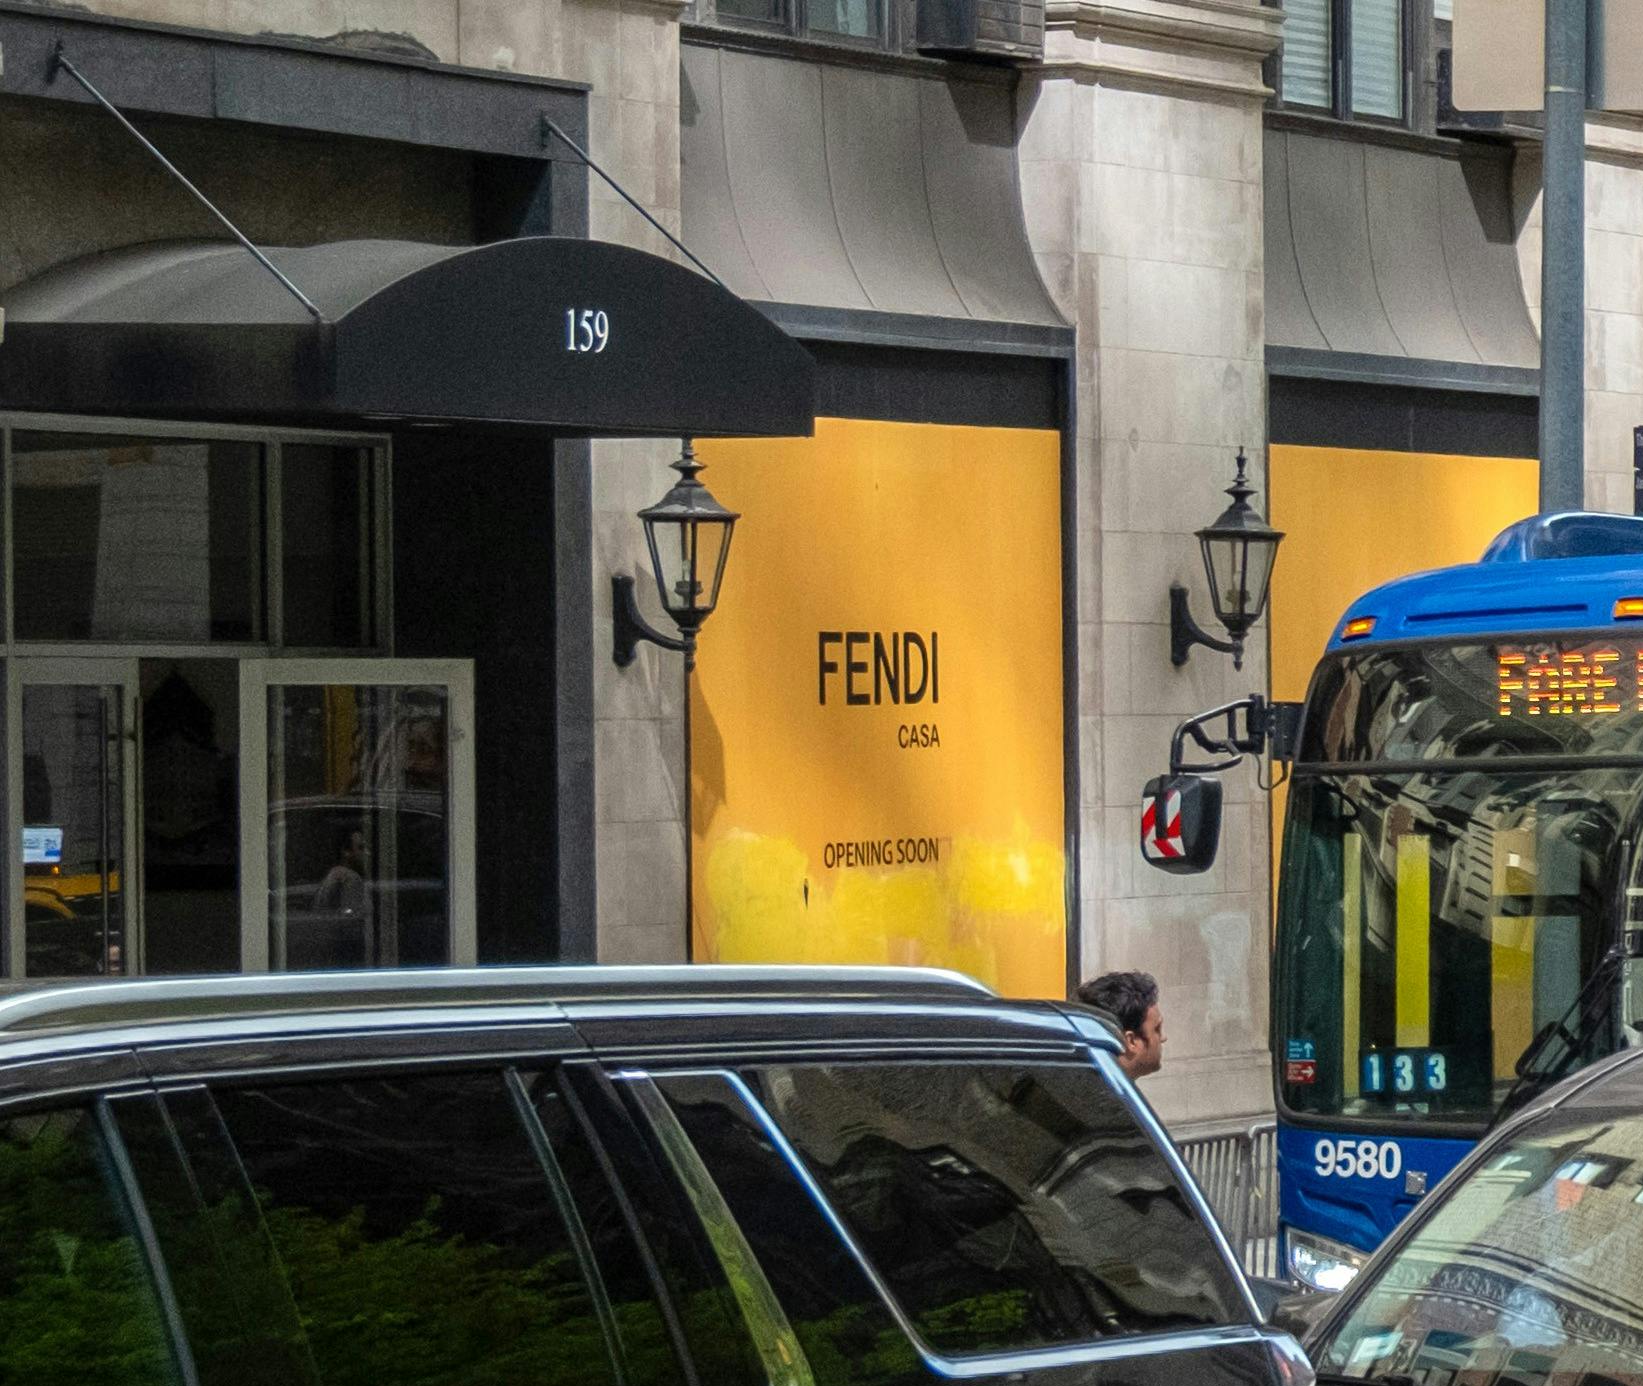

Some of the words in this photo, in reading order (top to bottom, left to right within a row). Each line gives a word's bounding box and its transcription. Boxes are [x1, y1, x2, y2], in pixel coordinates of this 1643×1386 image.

[565, 309, 610, 354] 159
[818, 630, 939, 706] FENDI
[1499, 650, 1621, 716] FARE
[898, 724, 941, 750] CASA
[823, 840, 893, 870] OPENING
[896, 837, 940, 865] SOON
[1314, 1138, 1402, 1179] 9580
